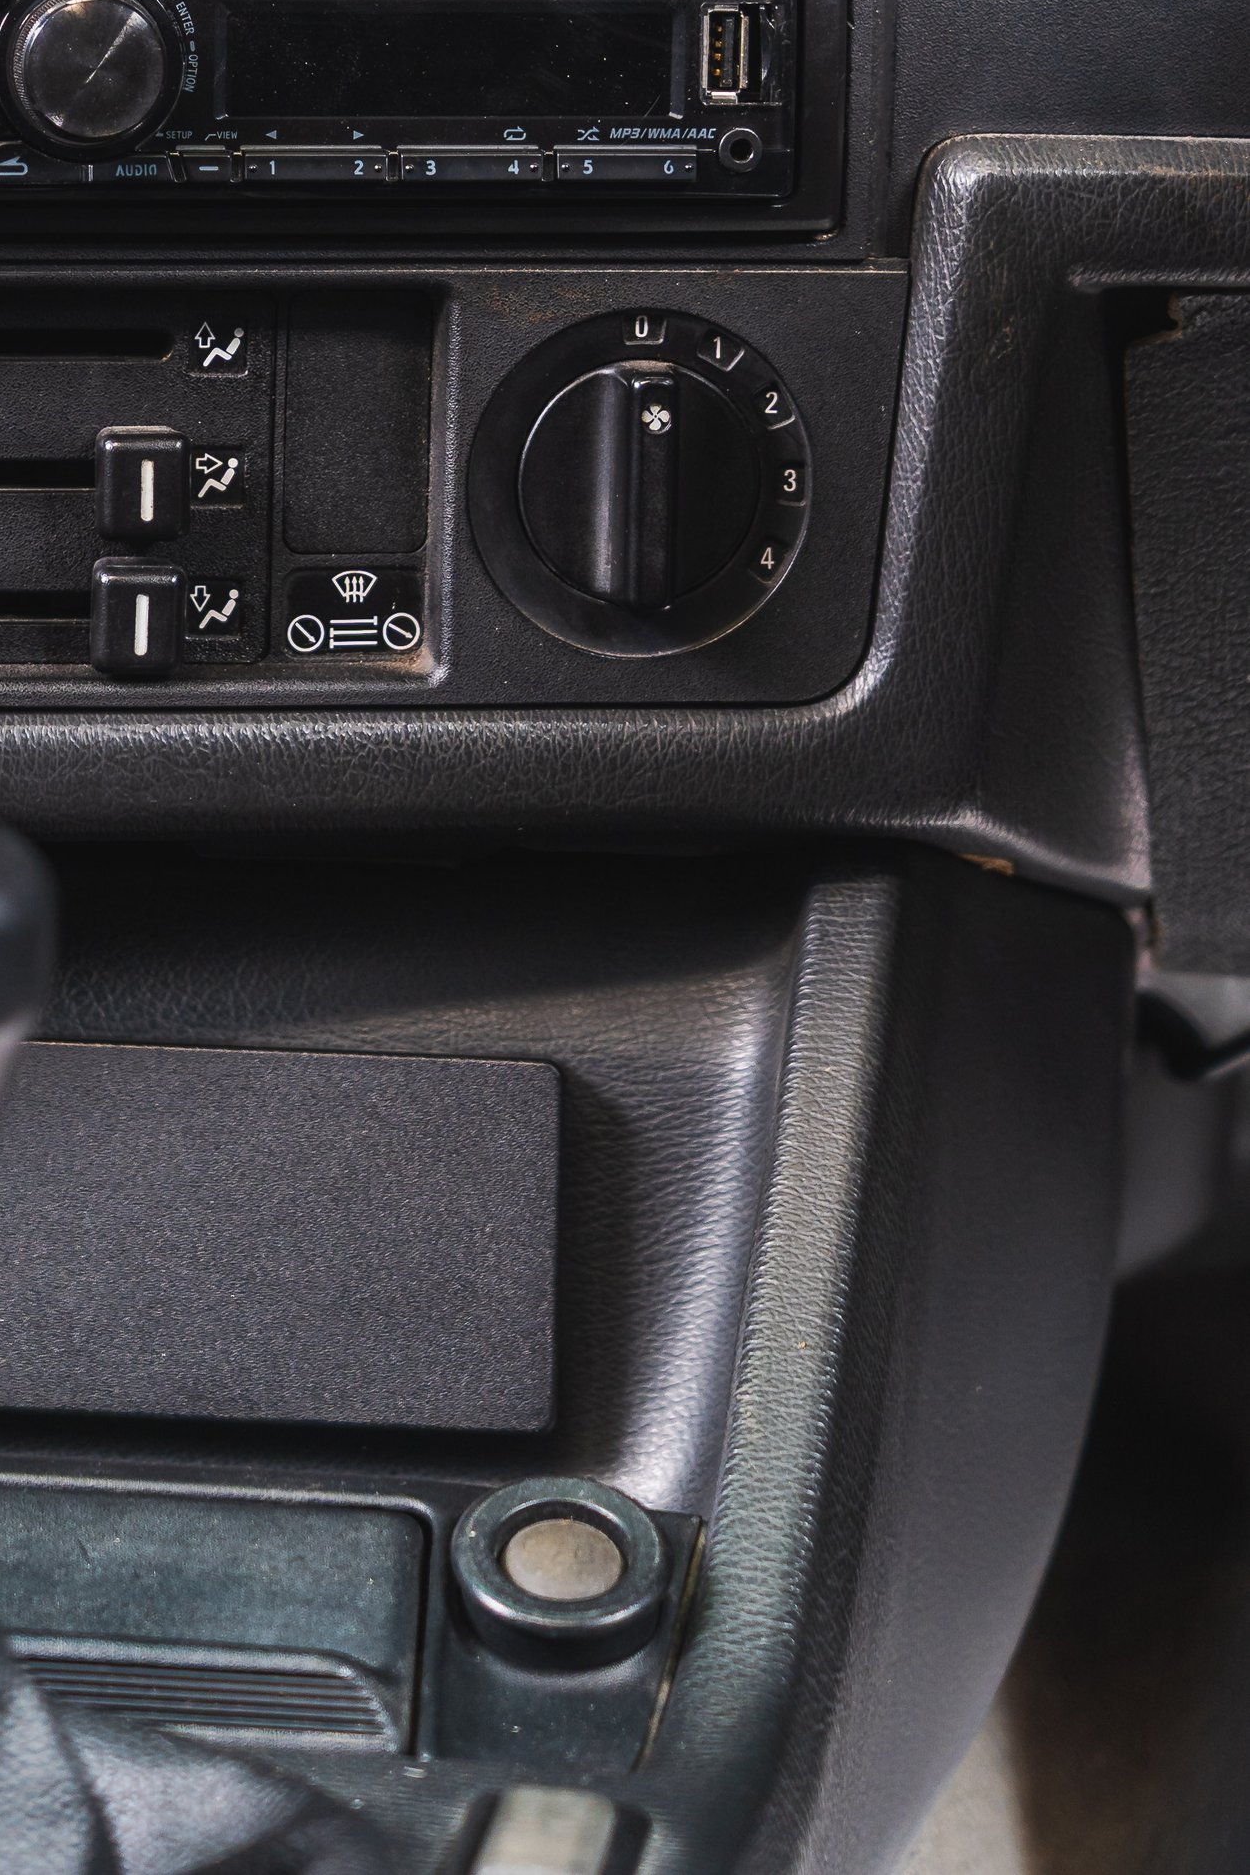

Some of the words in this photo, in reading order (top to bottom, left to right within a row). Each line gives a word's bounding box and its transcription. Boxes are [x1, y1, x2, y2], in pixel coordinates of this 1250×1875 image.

[175, 1, 195, 36] ENTER
[182, 54, 199, 93] OPTION
[165, 130, 193, 140] SETUP
[216, 130, 238, 140] VIEW
[609, 128, 717, 140] MP3/WMA/AAC
[269, 160, 276, 175] 1
[354, 160, 364, 175] 2
[425, 160, 437, 175] 3
[507, 160, 520, 175] 4
[582, 160, 594, 175] 5
[663, 160, 674, 174] 6
[634, 315, 649, 339] 0
[712, 336, 722, 359] 1
[764, 391, 778, 414] 2
[783, 469, 797, 492] 3
[760, 547, 775, 570] 4
